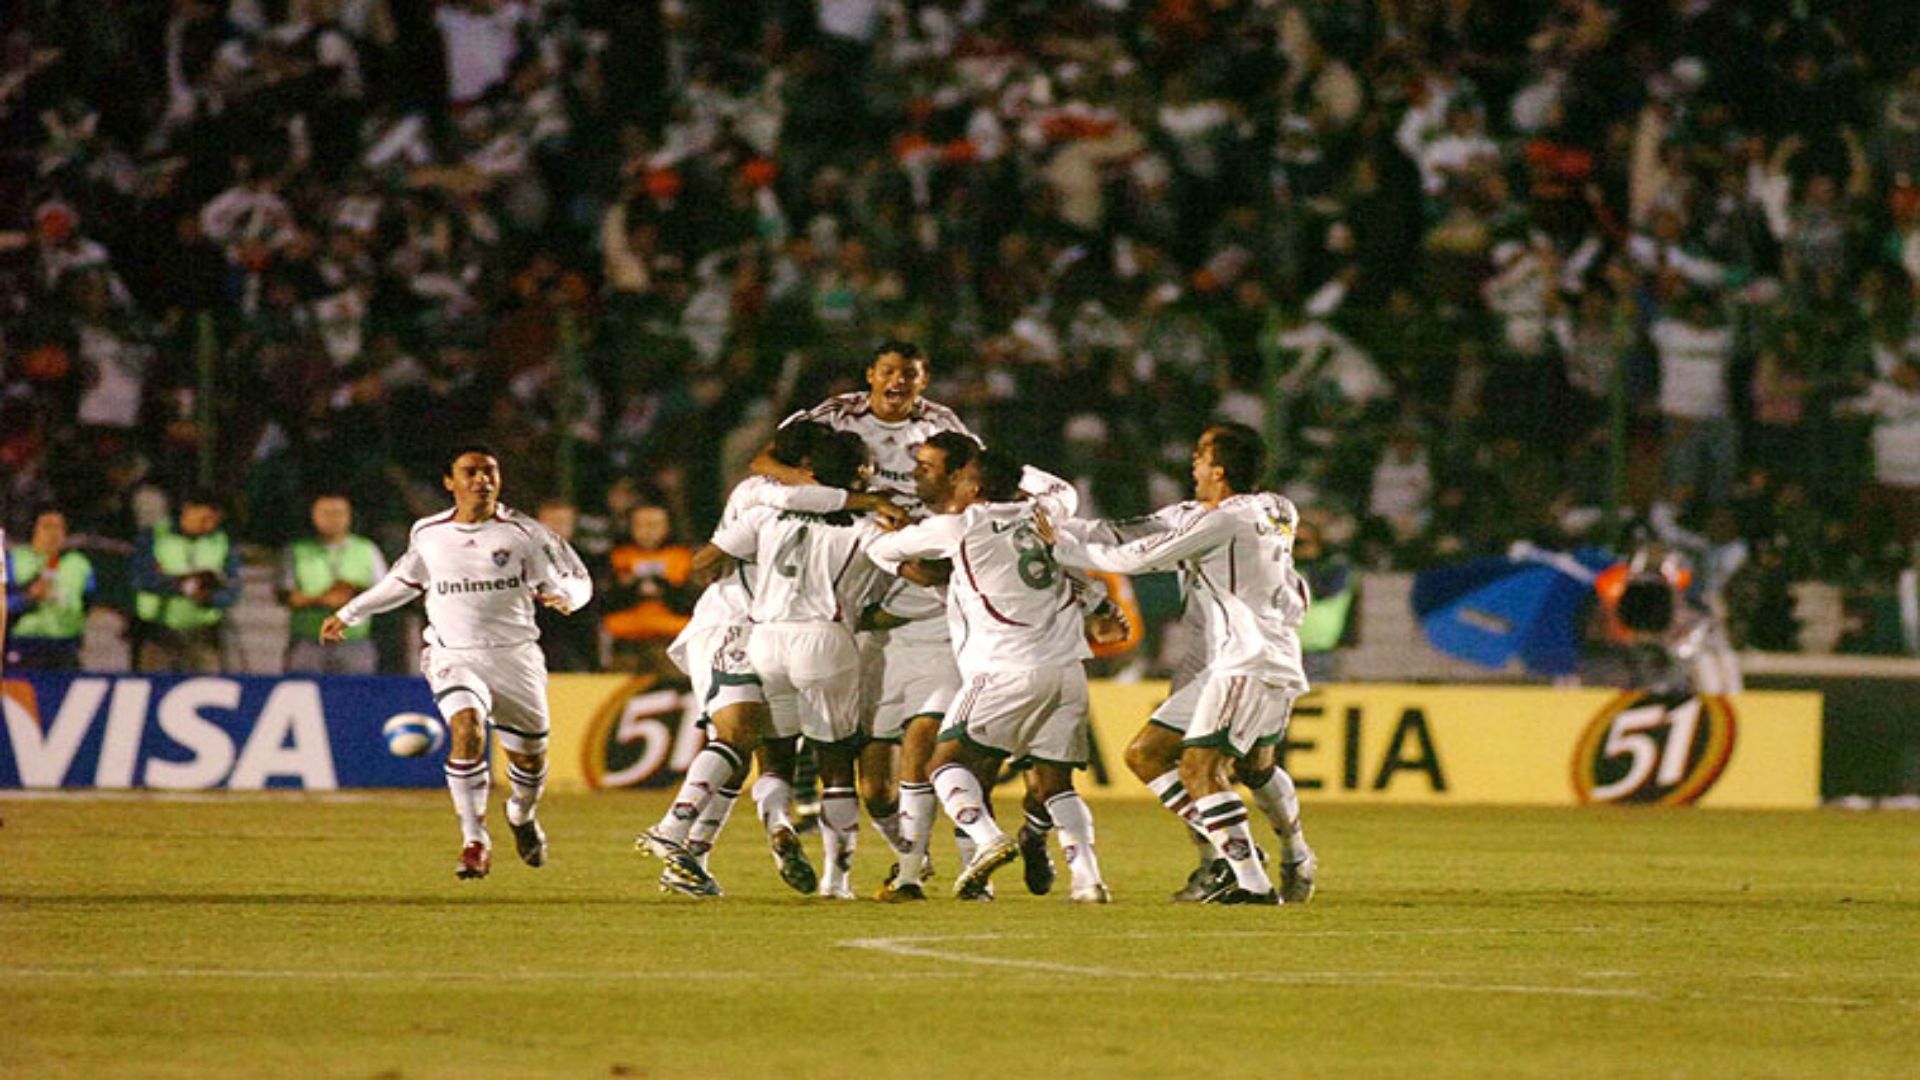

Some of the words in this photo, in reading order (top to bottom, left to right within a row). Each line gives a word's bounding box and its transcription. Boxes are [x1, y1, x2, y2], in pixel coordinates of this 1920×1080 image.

[437, 575, 521, 595] Unimed
[1013, 521, 1058, 590] 8
[1, 678, 339, 790] VISA
[602, 689, 704, 787] 51
[1592, 697, 1702, 799] 51
